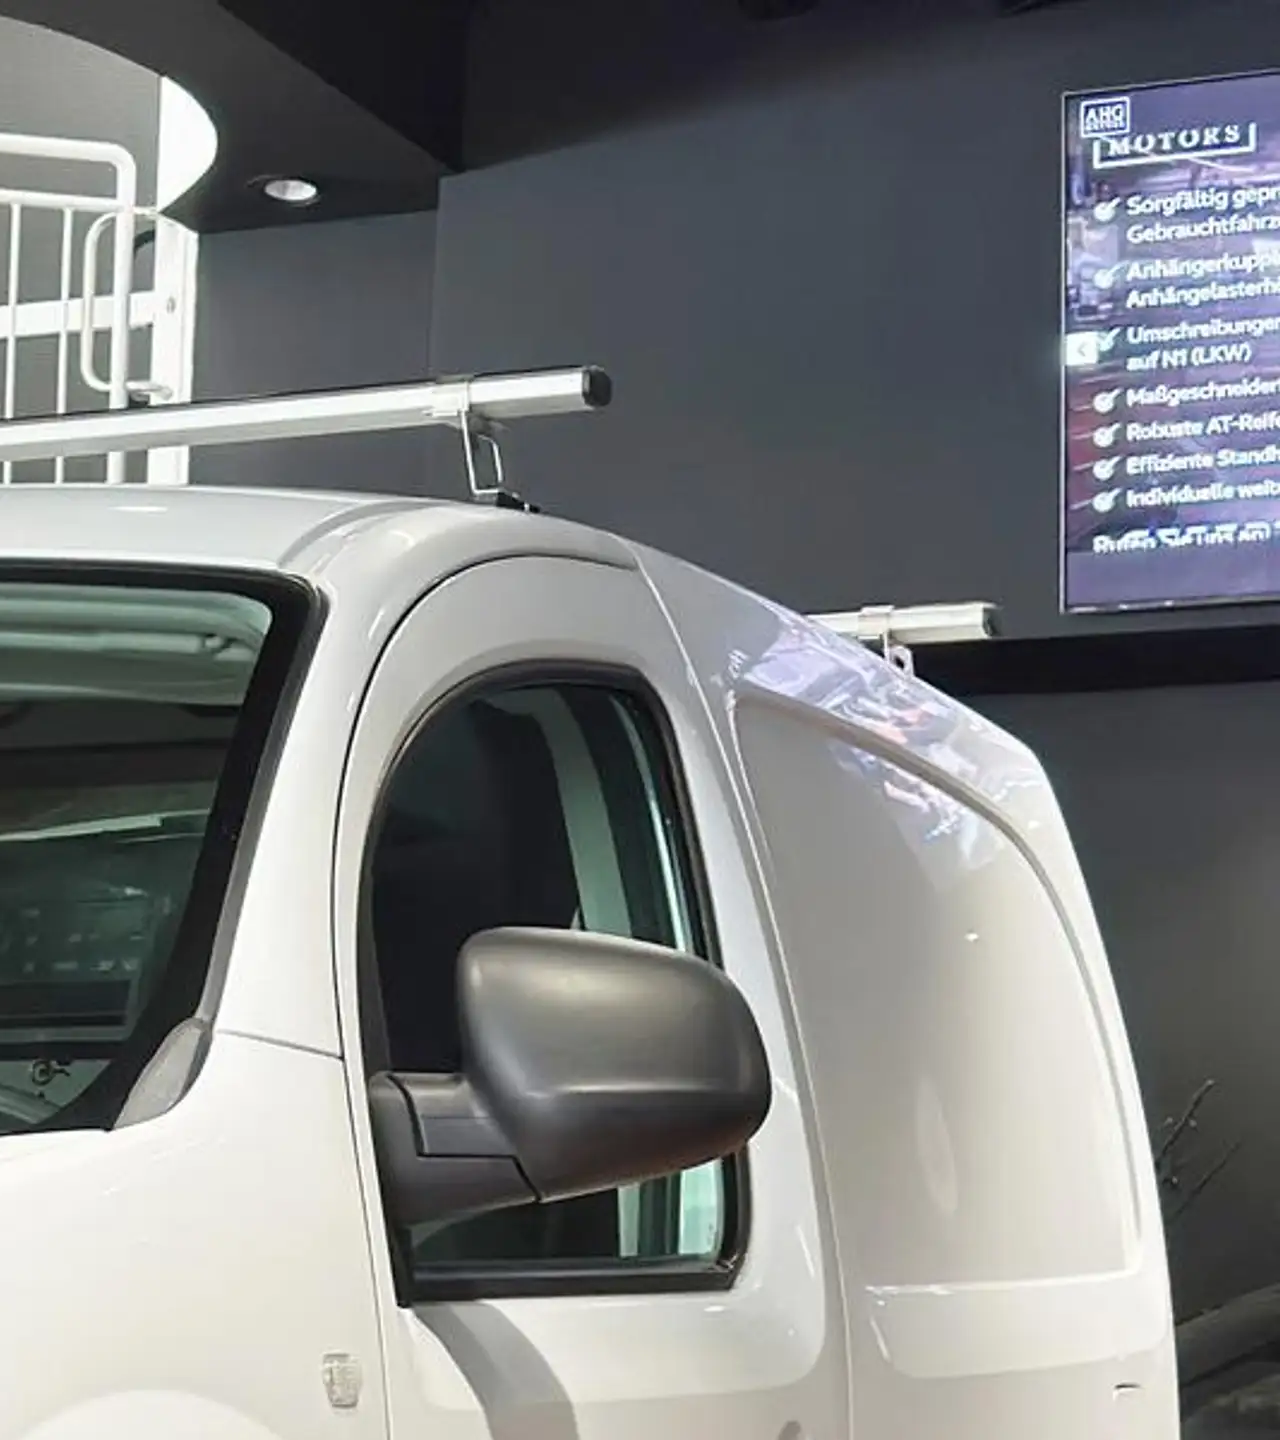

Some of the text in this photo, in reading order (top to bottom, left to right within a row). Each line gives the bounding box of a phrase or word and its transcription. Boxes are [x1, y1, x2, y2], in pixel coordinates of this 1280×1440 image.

[1109, 124, 1240, 156] MOTORS
[1127, 187, 1229, 217] Sorgfältig
[1191, 341, 1252, 366] (LKW)
[1126, 482, 1235, 508] Individuelle
